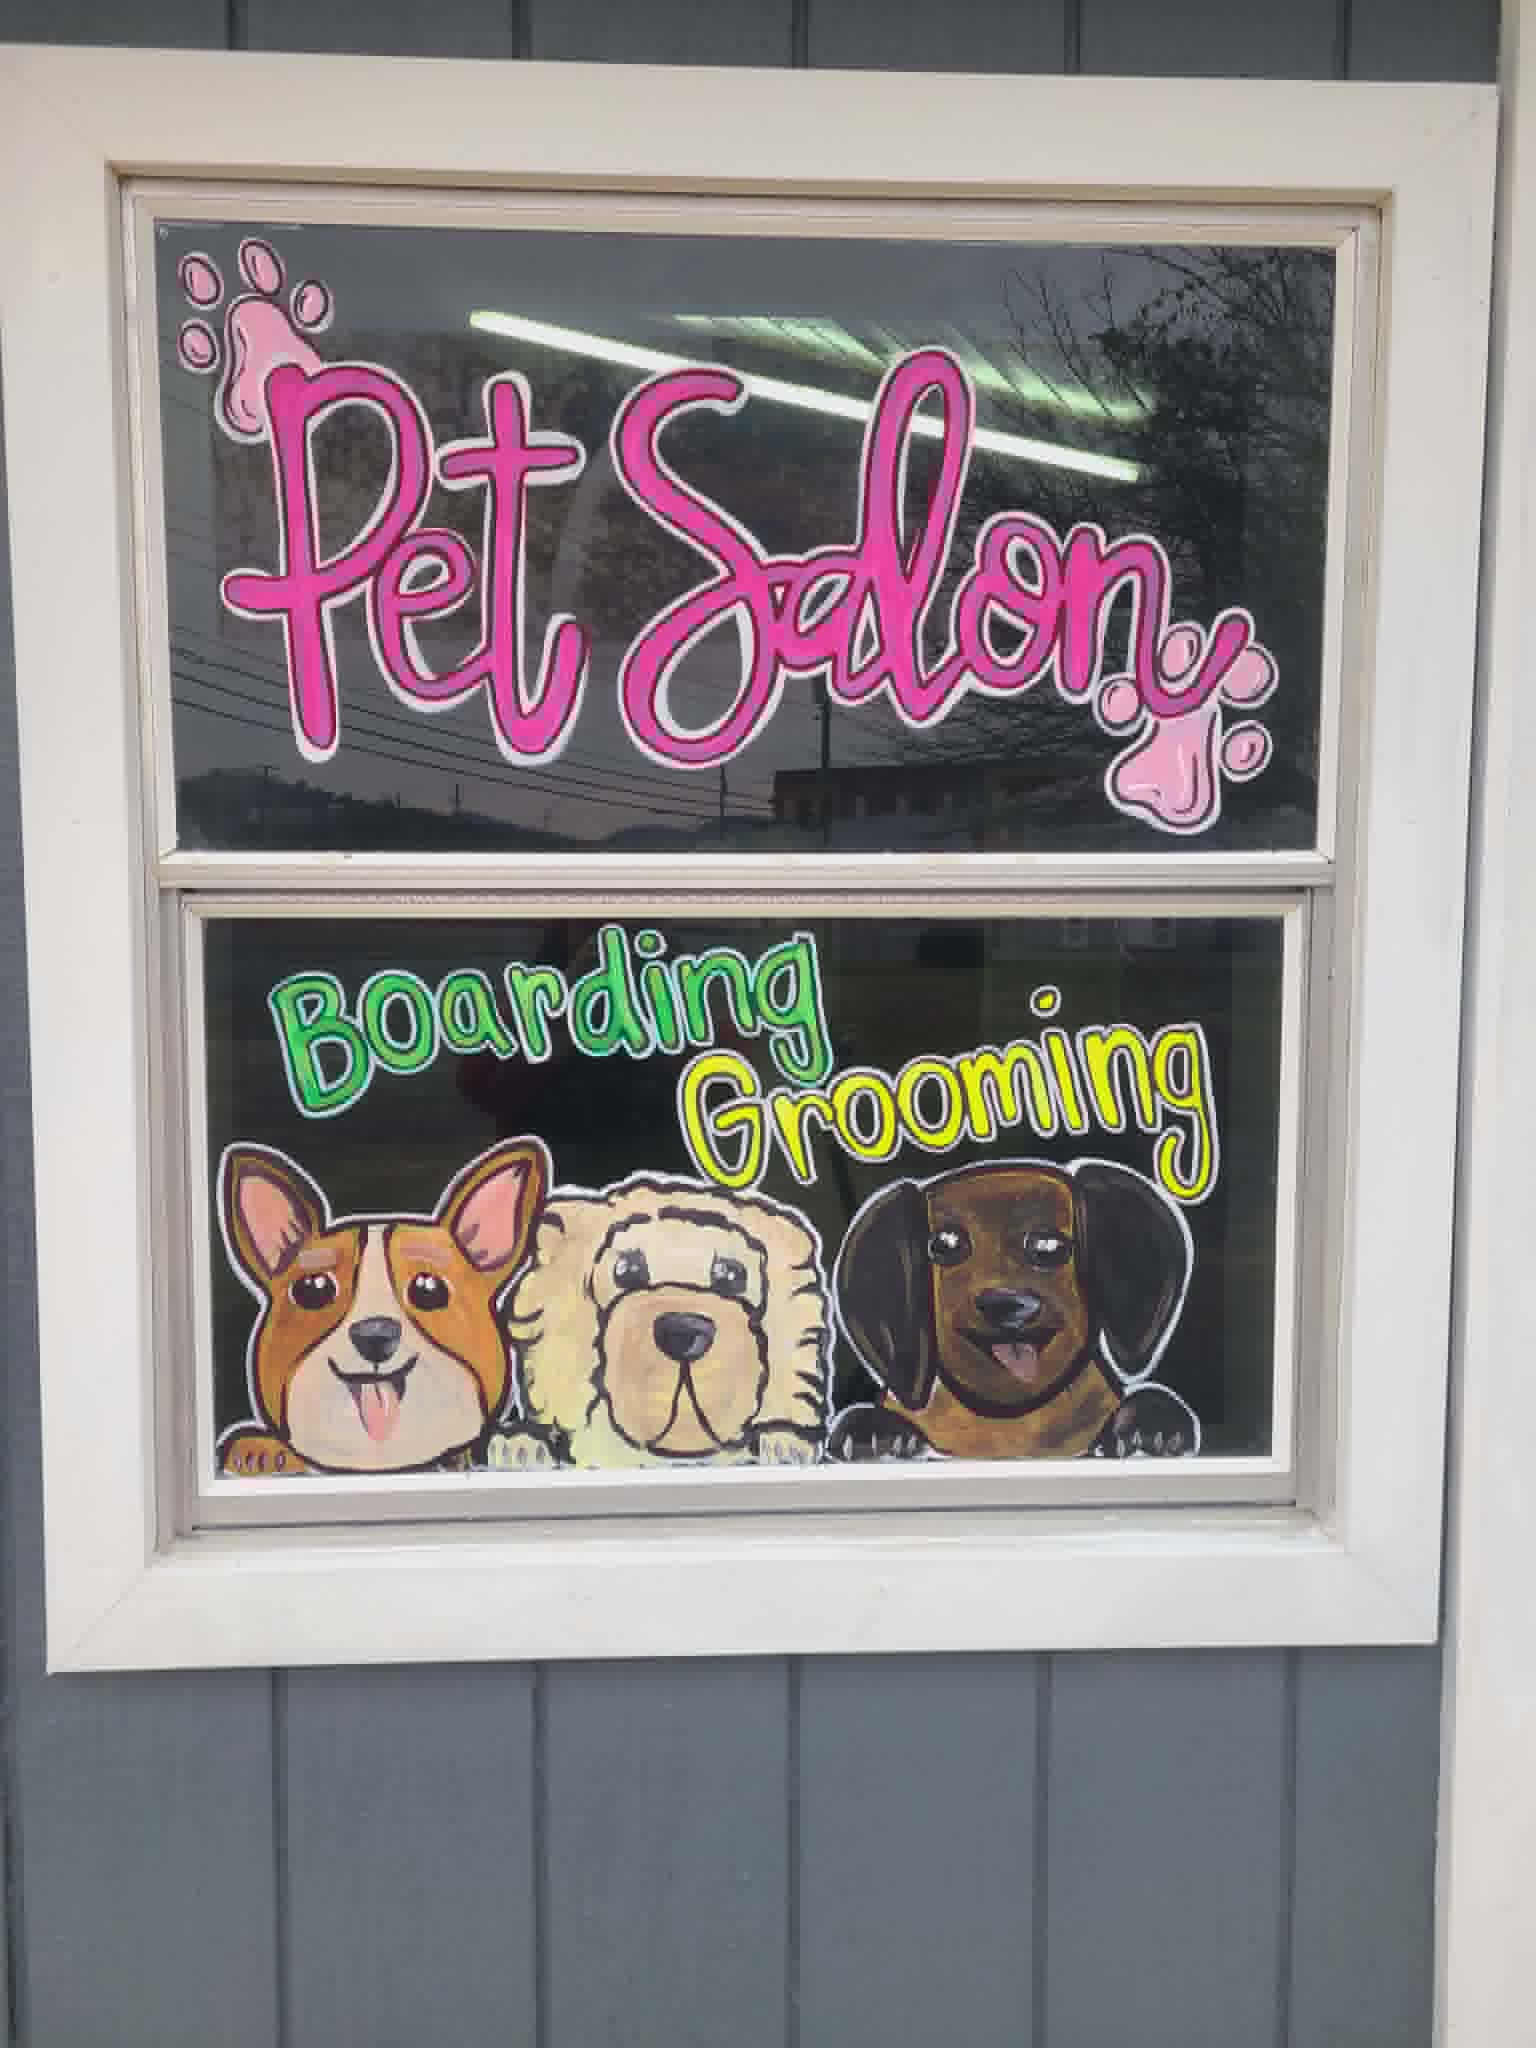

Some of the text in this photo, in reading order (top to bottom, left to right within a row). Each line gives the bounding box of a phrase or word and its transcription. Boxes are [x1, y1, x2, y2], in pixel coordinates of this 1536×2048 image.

[222, 347, 1252, 768] Pet Salon
[267, 924, 834, 1118] Boarding
[676, 986, 1219, 1201] Grooming
